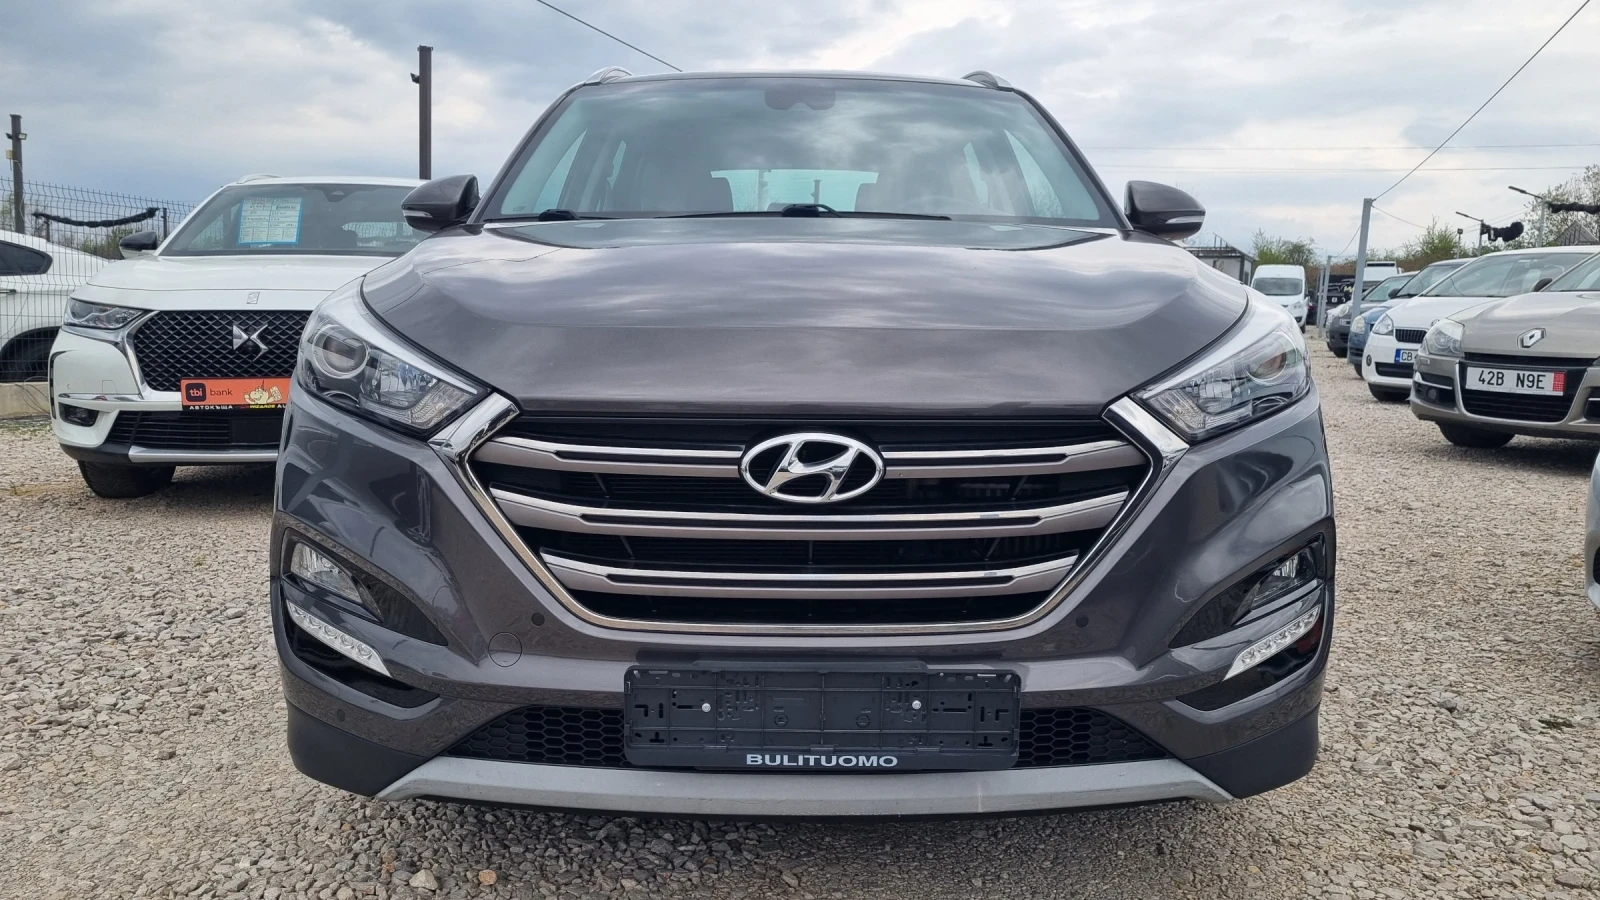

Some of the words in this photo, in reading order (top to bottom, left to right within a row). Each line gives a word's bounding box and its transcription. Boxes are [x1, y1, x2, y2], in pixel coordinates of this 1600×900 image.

[1478, 370, 1505, 386] 42B
[1516, 373, 1546, 389] N9E
[189, 388, 203, 397] tbi
[209, 388, 233, 396] bank
[746, 754, 898, 767] BULITUOMO
